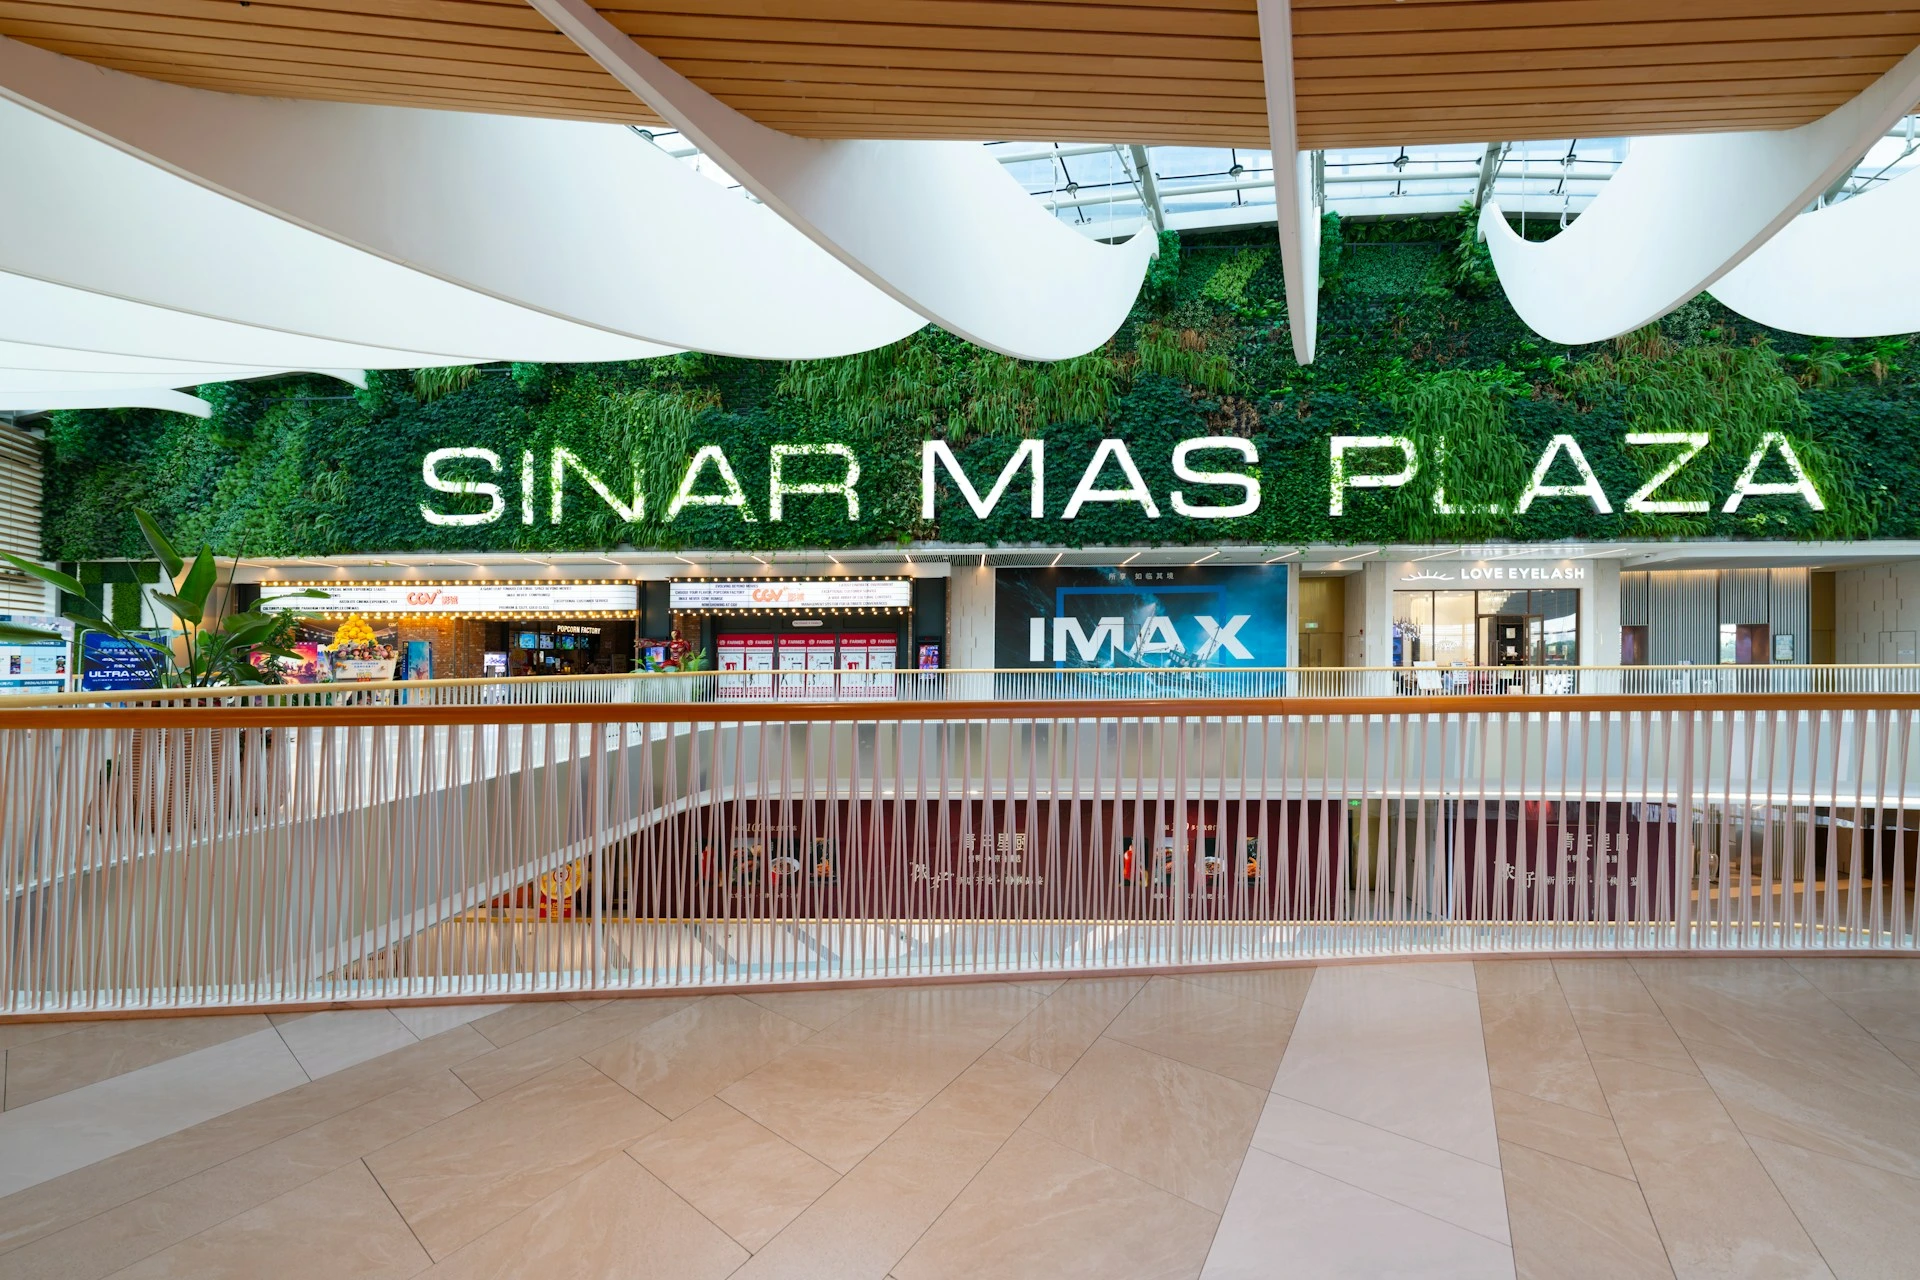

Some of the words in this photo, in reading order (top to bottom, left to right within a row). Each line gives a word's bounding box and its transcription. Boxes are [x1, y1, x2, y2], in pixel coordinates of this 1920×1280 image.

[419, 444, 860, 526] SINAR
[922, 436, 1261, 519] MAS
[1329, 431, 1826, 517] PLAZA
[1460, 567, 1503, 580] LOVE
[1508, 567, 1585, 580] EYELASH
[407, 592, 437, 605] CGV
[752, 588, 783, 602] CGV
[556, 625, 580, 633] POPCORN
[581, 626, 601, 635] FACTORY
[1029, 615, 1255, 661] IMAX
[89, 670, 130, 678] ULTRA
